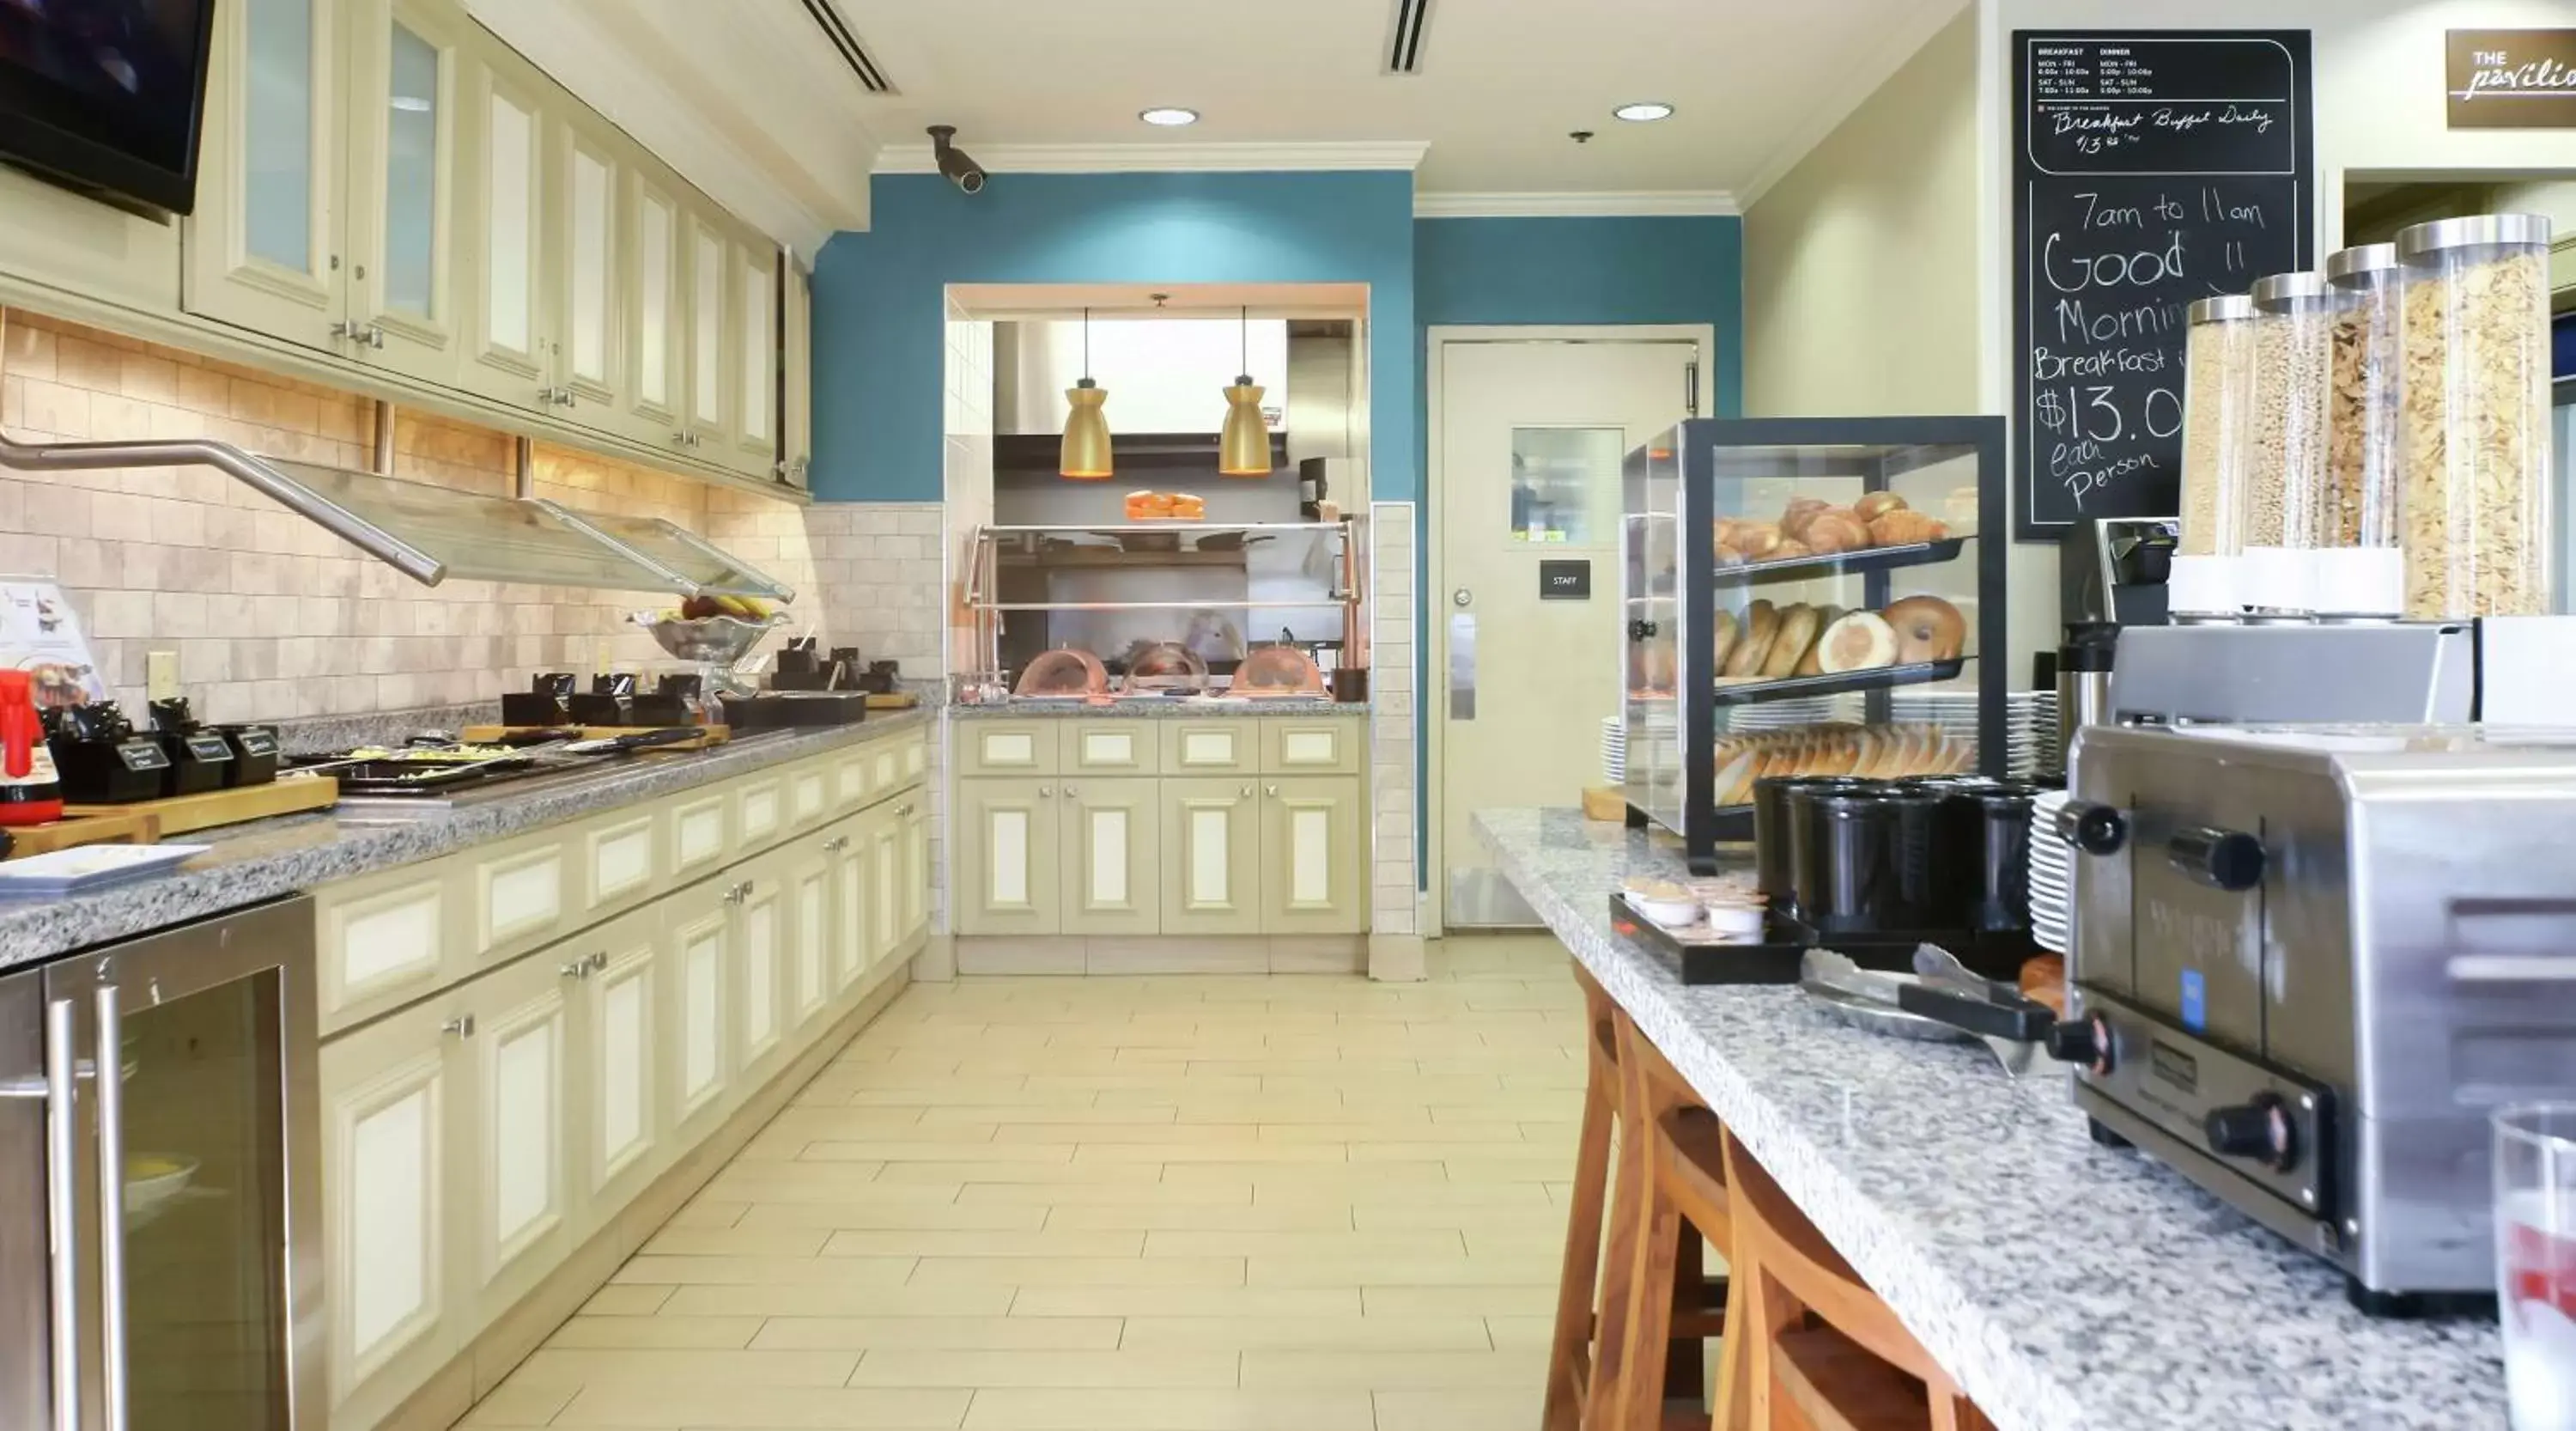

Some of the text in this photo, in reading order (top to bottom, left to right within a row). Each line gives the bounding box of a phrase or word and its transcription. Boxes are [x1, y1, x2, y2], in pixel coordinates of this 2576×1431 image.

[2473, 51, 2507, 64] THE
[2052, 111, 2144, 135] Breakfast
[2218, 105, 2274, 133] Daily
[2074, 192, 2143, 230] 7am
[2153, 193, 2184, 221] to
[2044, 229, 2186, 292] Good
[2034, 347, 2165, 381] Breakfast
[1553, 576, 1577, 585] STAFF
